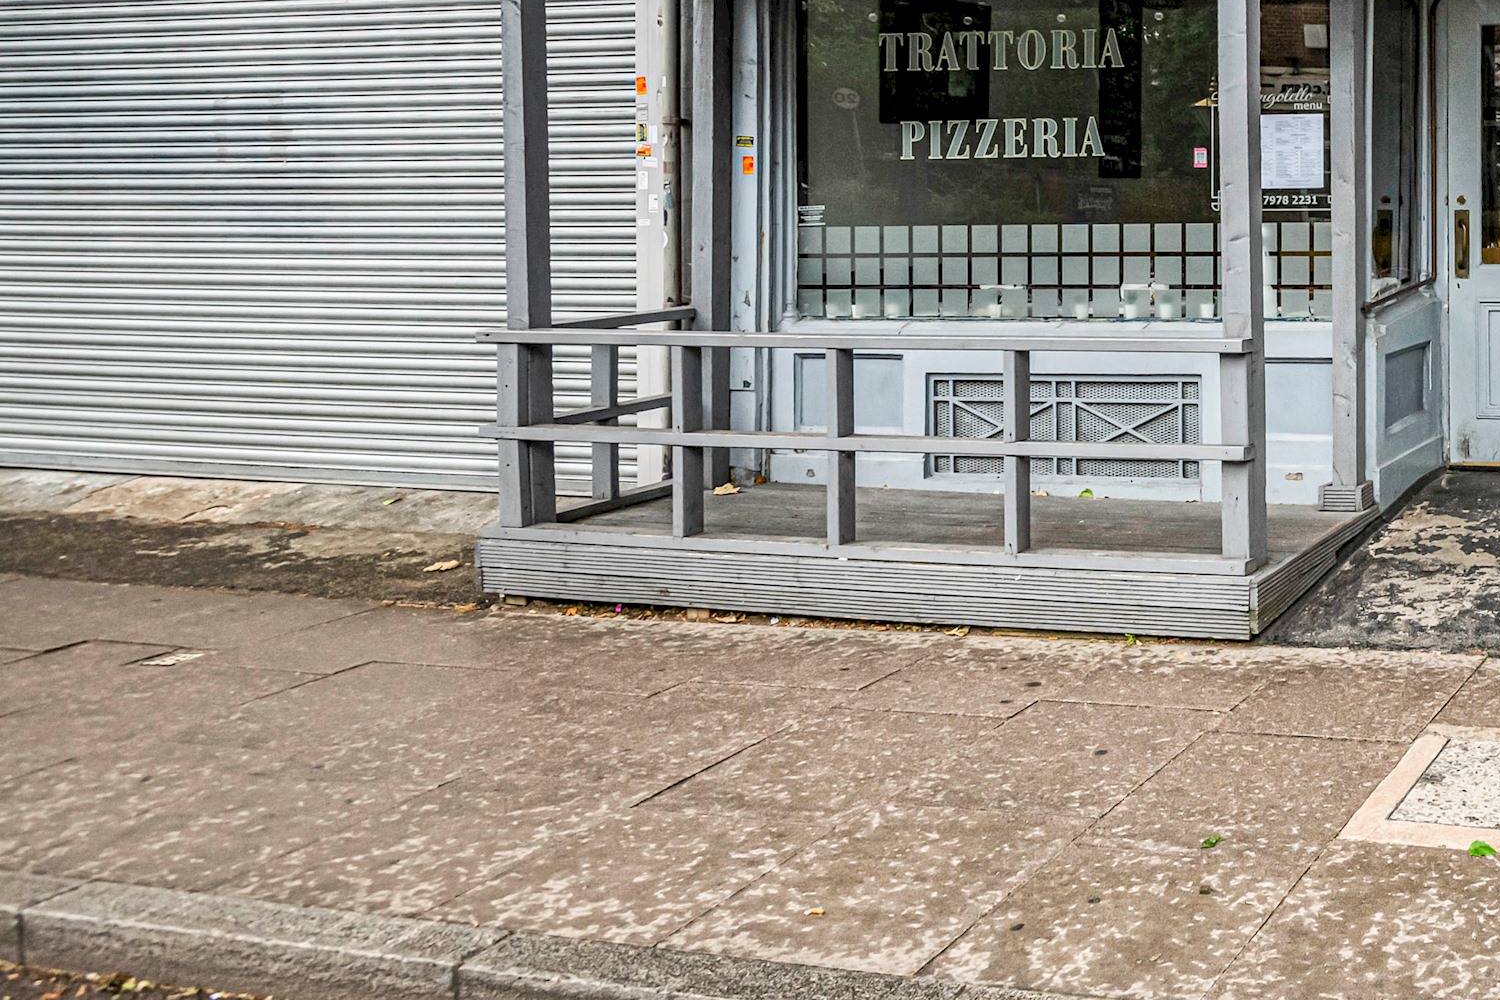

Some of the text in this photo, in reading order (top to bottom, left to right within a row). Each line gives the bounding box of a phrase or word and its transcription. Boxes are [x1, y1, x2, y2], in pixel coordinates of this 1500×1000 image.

[878, 28, 1125, 72] TRATTORIA
[1293, 101, 1323, 110] menu
[900, 116, 1106, 160] PIZZERIA
[1262, 195, 1319, 206] 7978 2231
